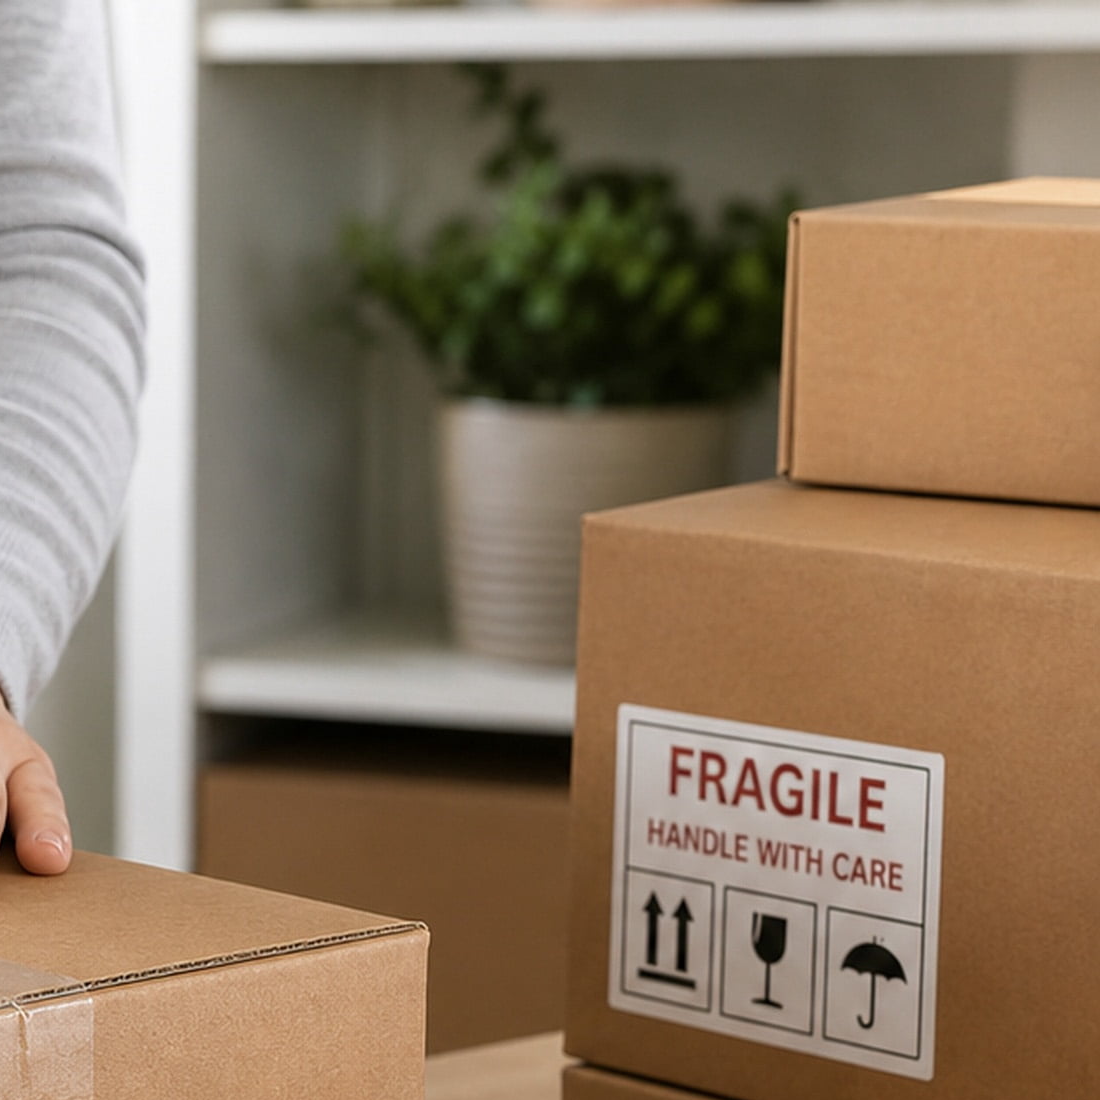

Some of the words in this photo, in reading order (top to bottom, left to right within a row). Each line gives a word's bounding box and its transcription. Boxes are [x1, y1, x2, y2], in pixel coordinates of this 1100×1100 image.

[668, 746, 887, 833] FRAGILE
[647, 818, 749, 863] HANDLE
[757, 837, 824, 877] WITH
[832, 852, 904, 892] CARE
